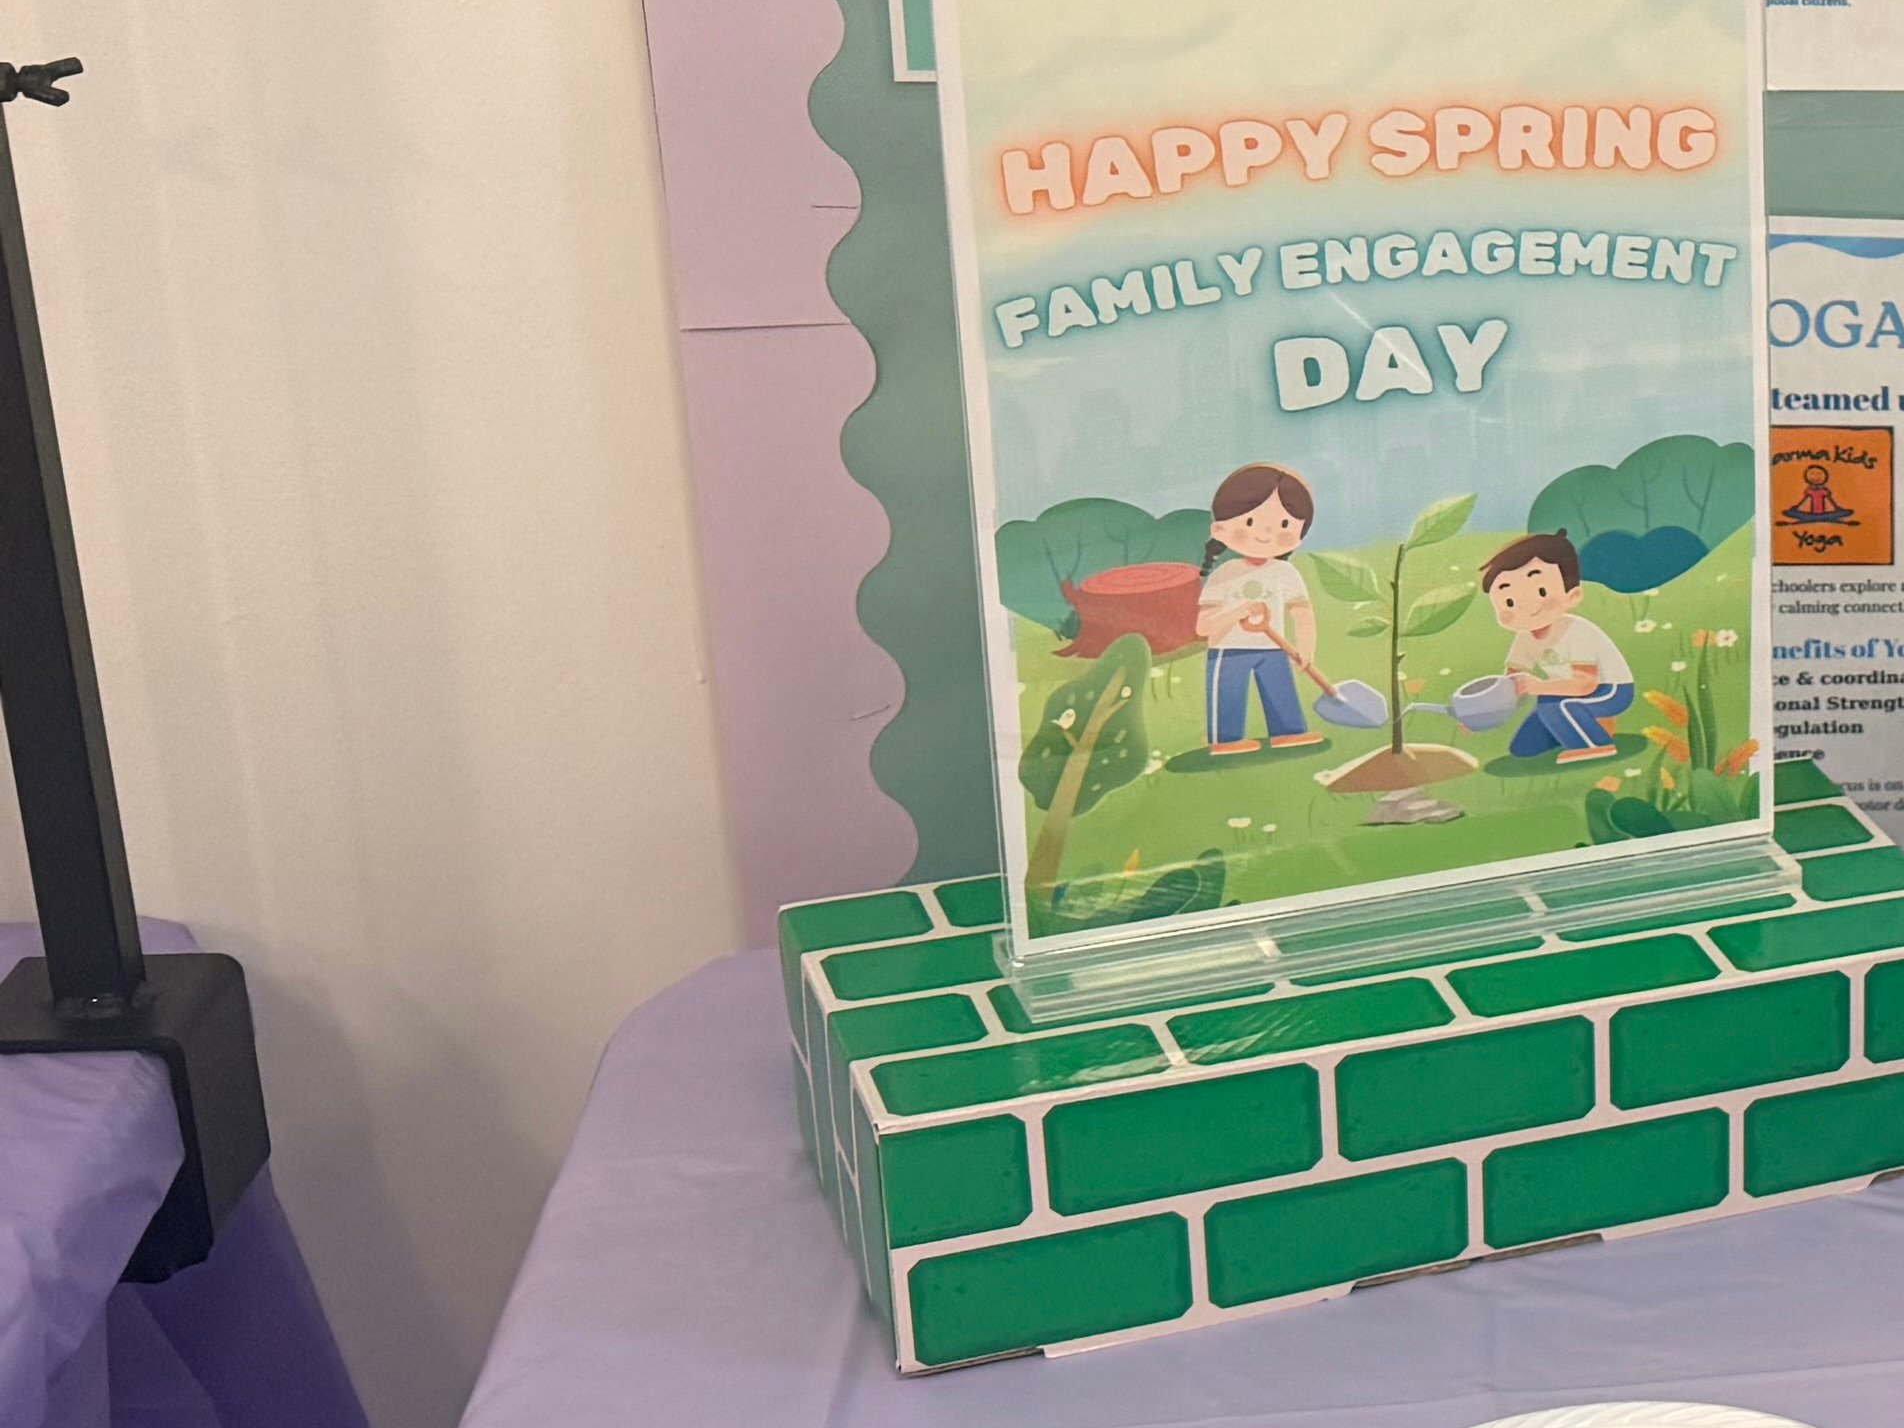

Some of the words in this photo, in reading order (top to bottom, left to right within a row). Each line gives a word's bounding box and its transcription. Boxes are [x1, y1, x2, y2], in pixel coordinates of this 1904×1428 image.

[1000, 111, 1351, 216] HAPPY
[1368, 104, 1720, 179] SPRING
[993, 246, 1264, 349] FAMILY
[1279, 228, 1739, 290] ENGAGEMENT
[1272, 317, 1510, 413] DAY
[1771, 385, 1890, 412] teamed
[1792, 531, 1844, 553] Yoga
[1778, 599, 1841, 617] calming
[1851, 638, 1880, 659] of
[1795, 671, 1814, 686] &
